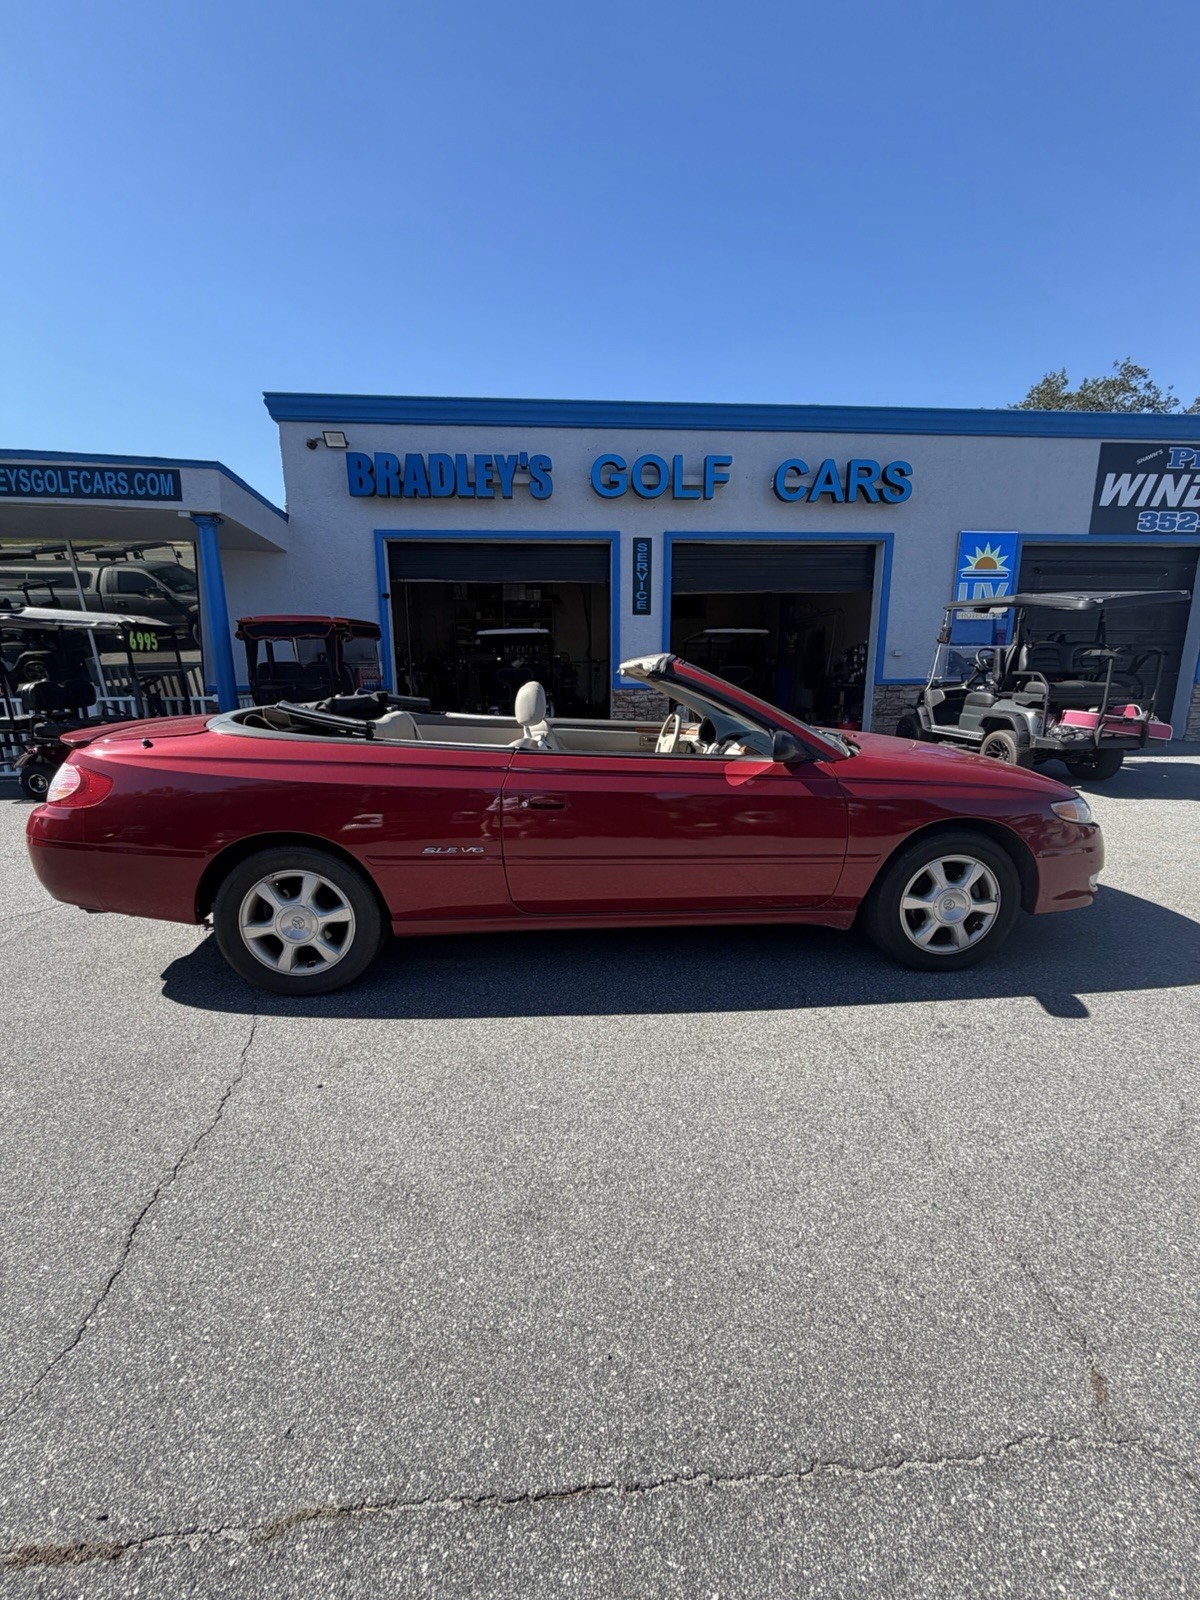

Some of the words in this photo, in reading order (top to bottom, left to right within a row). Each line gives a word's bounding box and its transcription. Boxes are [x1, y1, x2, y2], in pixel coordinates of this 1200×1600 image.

[1136, 449, 1164, 465] SHAWN'S
[0, 468, 175, 496] EYSGOLFCARS.COM
[346, 452, 553, 500] BRADLEY'S
[591, 454, 733, 500] GOLF
[773, 459, 913, 504] CARS
[636, 543, 648, 609] SERVICE
[128, 630, 158, 650] 6995
